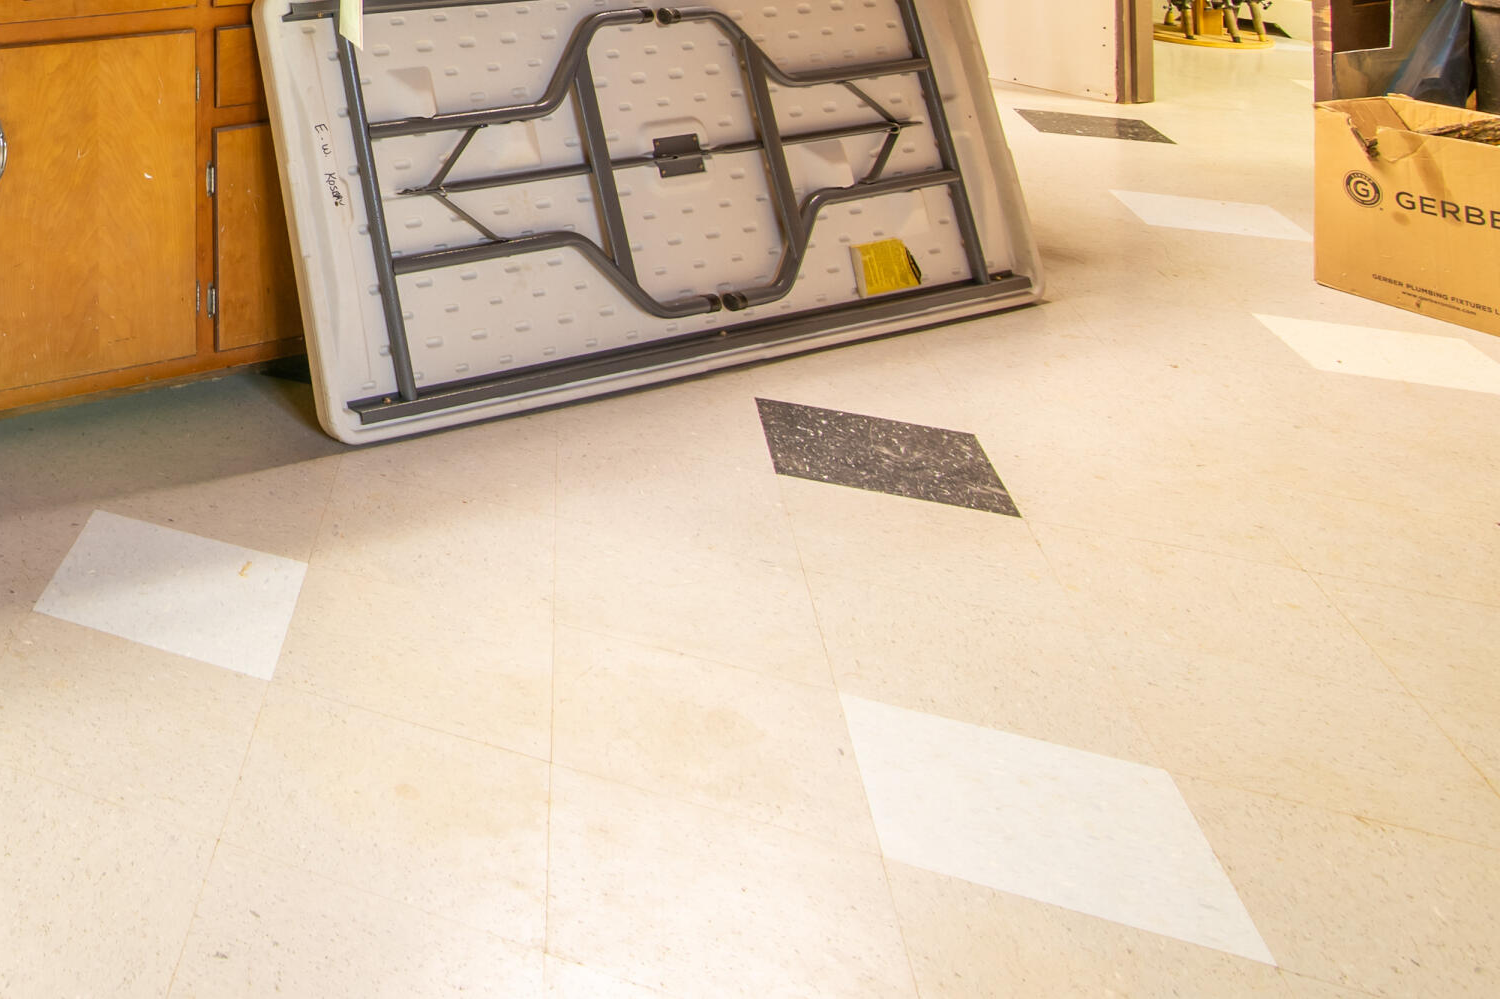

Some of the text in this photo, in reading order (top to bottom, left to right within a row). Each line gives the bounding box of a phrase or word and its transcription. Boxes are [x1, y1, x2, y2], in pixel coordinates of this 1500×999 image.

[1372, 274, 1404, 287] GERBER
[1406, 283, 1448, 300] PLUMBING
[1450, 296, 1493, 313] FIXTURES
